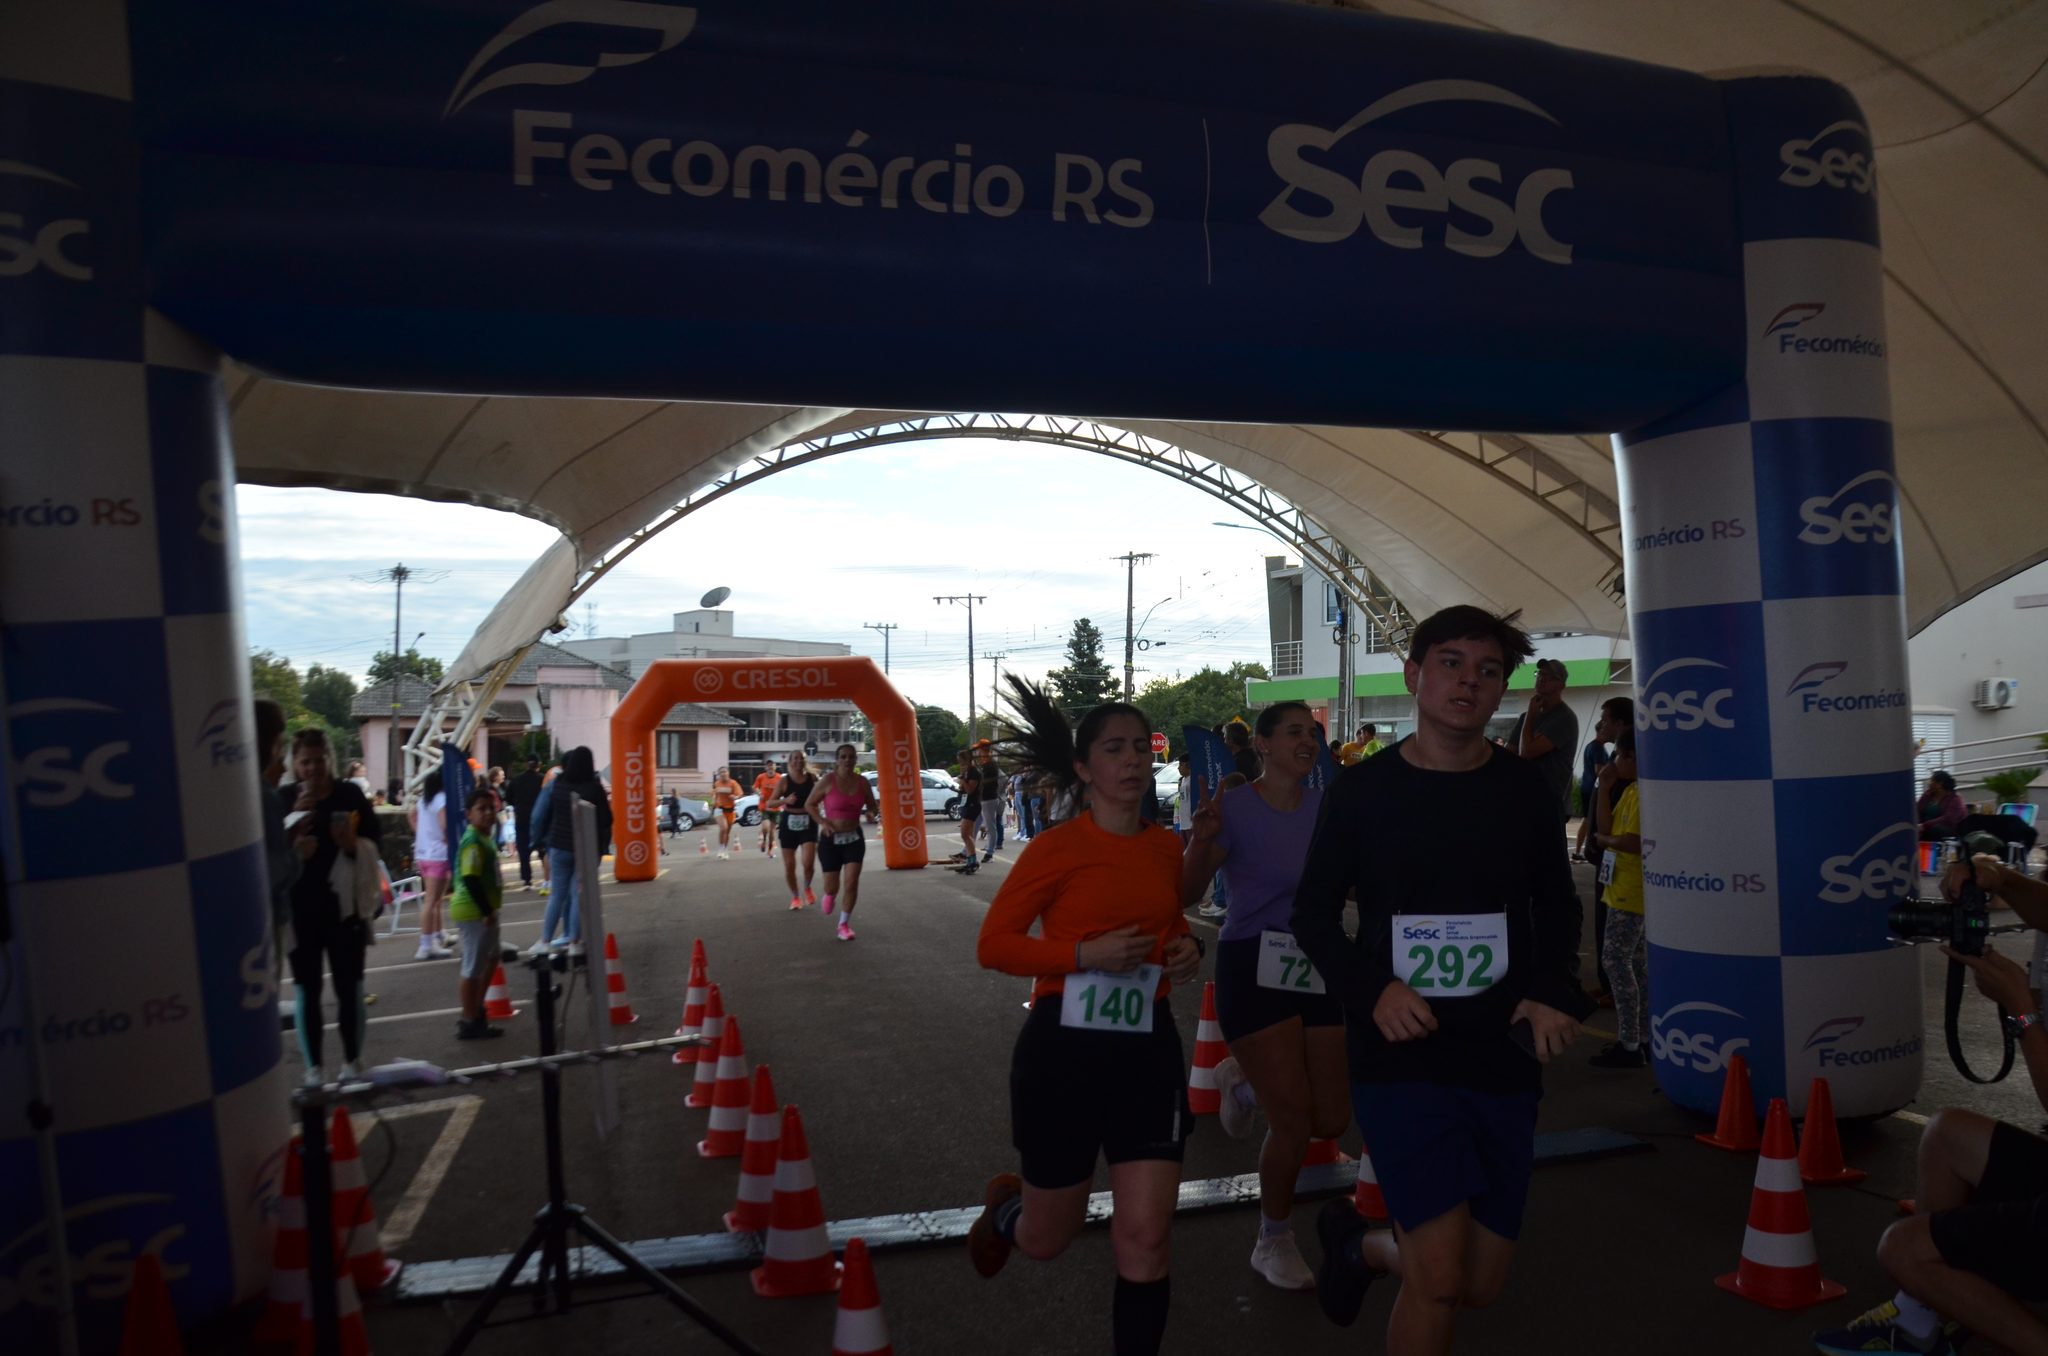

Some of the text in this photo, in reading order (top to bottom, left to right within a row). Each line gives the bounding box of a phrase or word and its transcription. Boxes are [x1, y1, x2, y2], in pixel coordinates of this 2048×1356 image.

[512, 108, 1155, 228] Fecomércio RS
[1257, 122, 1576, 265] Sesc
[91, 498, 142, 527] RS
[1711, 518, 1746, 541] RS
[731, 666, 837, 691] CRESOL
[1151, 739, 1166, 747] ARE
[624, 744, 645, 835] CRESOL
[894, 732, 917, 820] CRESOL
[1732, 873, 1766, 893] RS
[1403, 926, 1441, 940] Sesc
[1279, 955, 1312, 988] 72
[1408, 944, 1494, 988] 292
[143, 994, 190, 1027] RS
[1079, 984, 1144, 1026] 140
